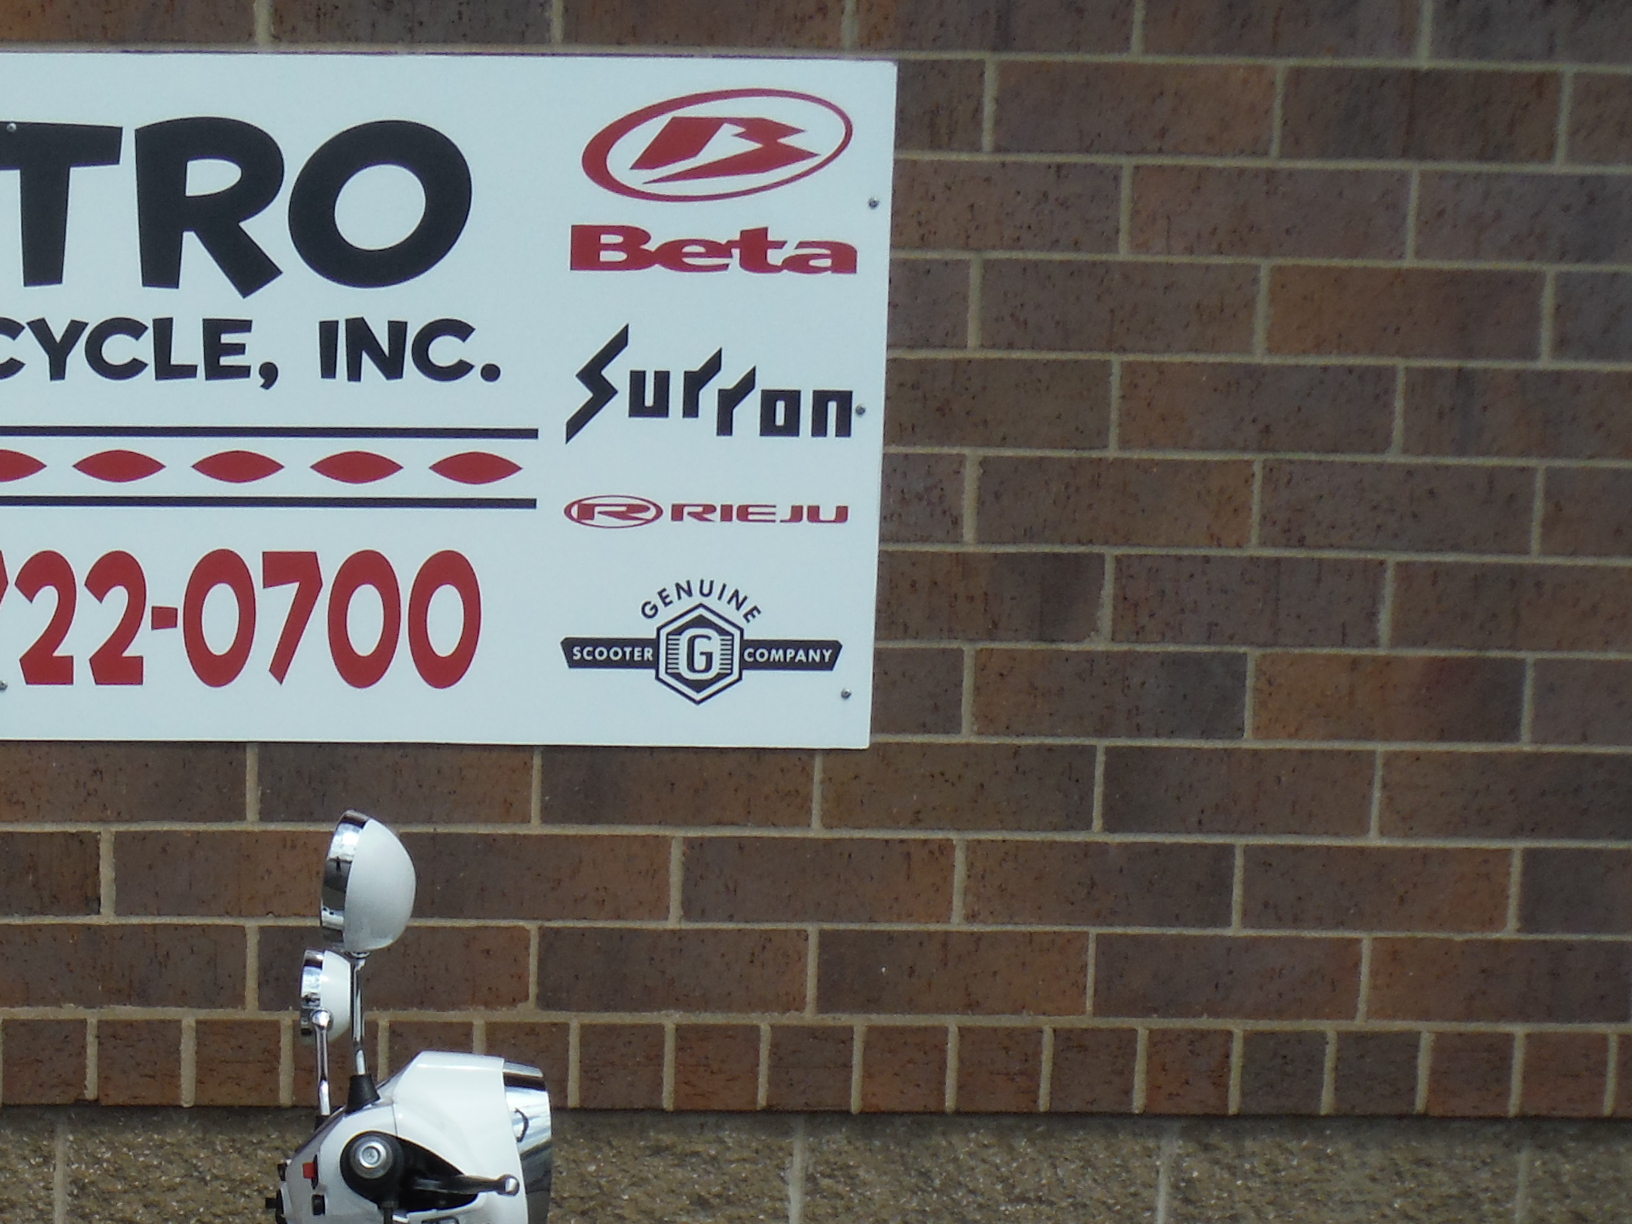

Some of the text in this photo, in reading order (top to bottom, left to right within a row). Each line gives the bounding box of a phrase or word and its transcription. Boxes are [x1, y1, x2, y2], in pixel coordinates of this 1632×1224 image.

[570, 224, 858, 274] Beta
[319, 316, 502, 384] INC.
[565, 323, 854, 444] Surron
[670, 504, 849, 524] RIEJU
[640, 578, 763, 624] GENUINE
[571, 634, 834, 674] SCOOTER G COMPANY
